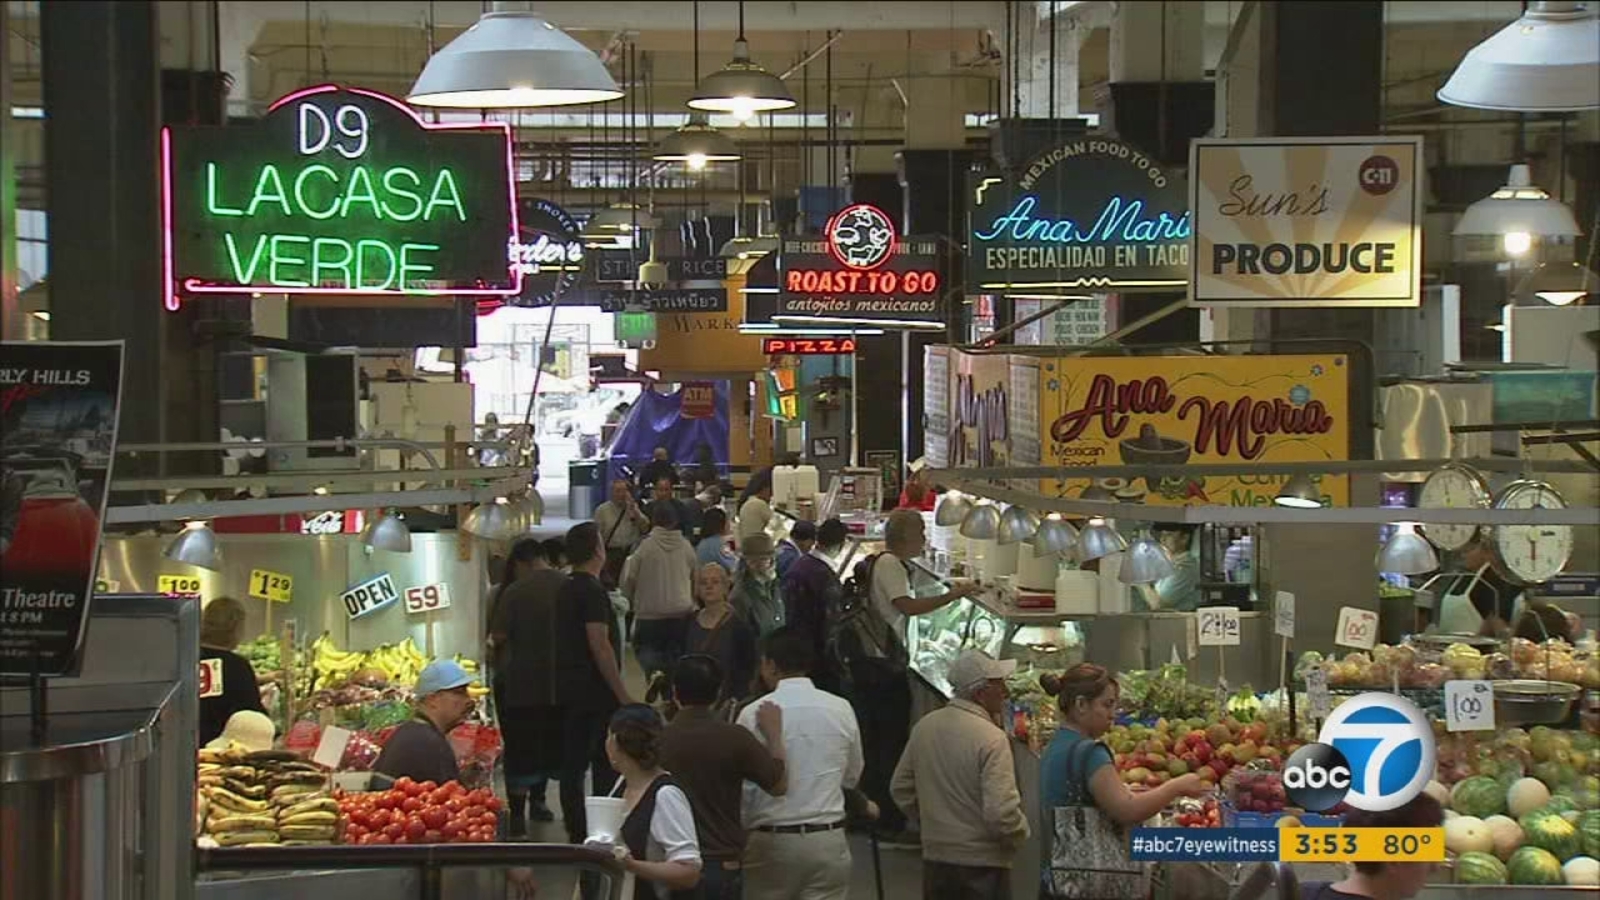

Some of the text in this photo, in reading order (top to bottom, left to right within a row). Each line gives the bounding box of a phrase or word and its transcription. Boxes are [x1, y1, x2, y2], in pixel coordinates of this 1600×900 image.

[299, 102, 369, 159] D9
[1020, 141, 1167, 190] MEXICAN FOOD TO GO
[1219, 174, 1331, 216] Sun's
[975, 196, 1191, 242] Ana Mari
[225, 232, 440, 294] VERDE
[603, 260, 724, 275] STI RICE
[986, 244, 1189, 269] ESPECIALIDAD EN TACO
[1212, 242, 1396, 275] PRODUCE
[787, 270, 937, 293] ROAST TO GO
[786, 296, 936, 316] antojitos mexicanos
[769, 339, 855, 353] PIZZA
[32, 369, 91, 386] HILLS
[1050, 373, 1175, 443] Ana
[1177, 395, 1333, 460] Maria
[1050, 445, 1106, 457] Mexican
[2, 588, 76, 608] Theatre
[344, 577, 396, 616] OPEN
